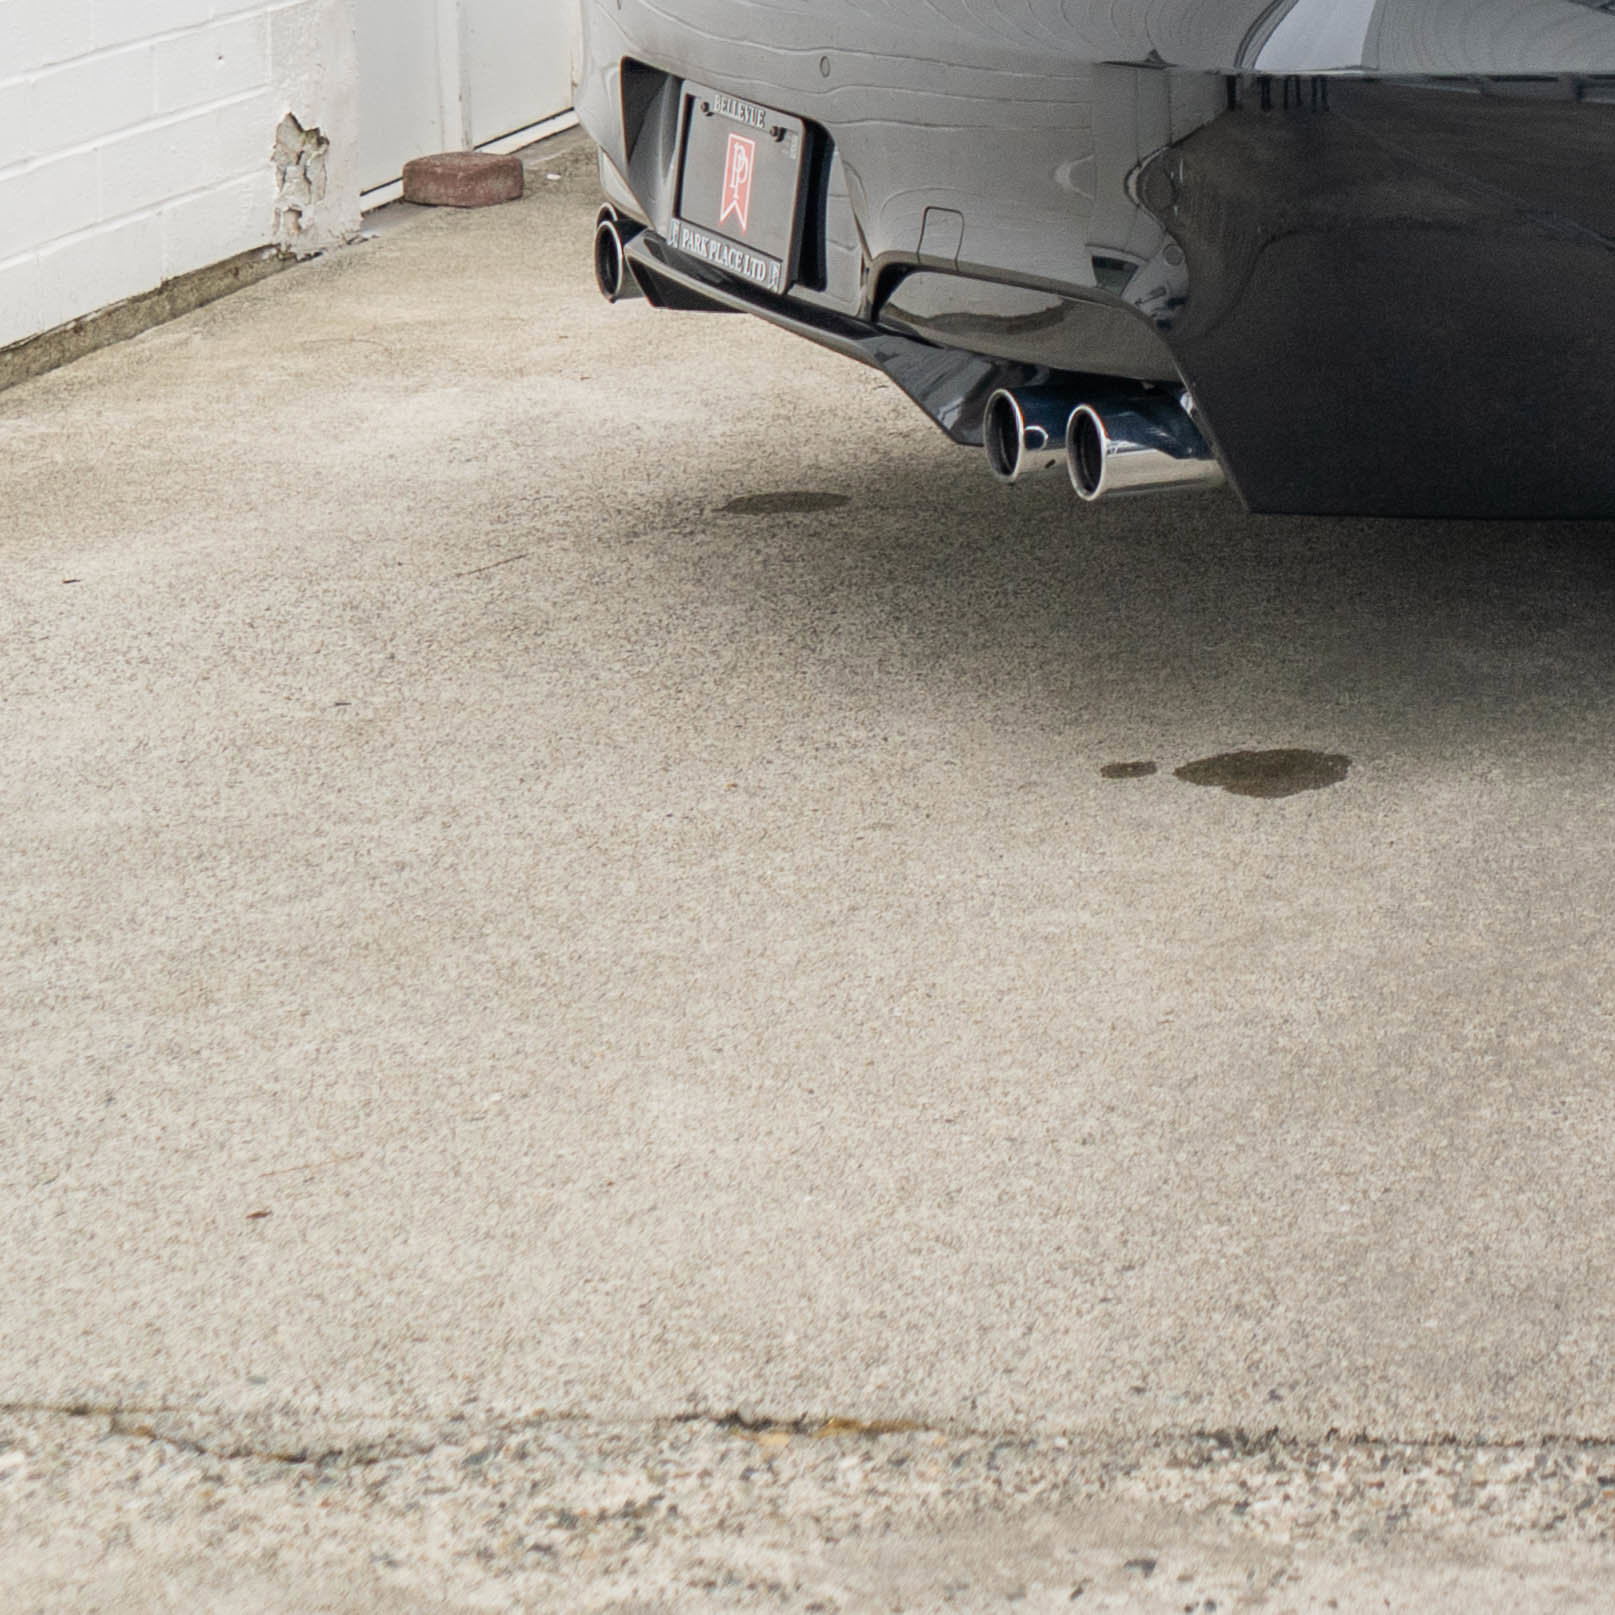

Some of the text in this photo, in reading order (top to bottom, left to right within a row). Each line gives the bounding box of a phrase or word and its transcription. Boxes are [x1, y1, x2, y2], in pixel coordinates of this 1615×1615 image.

[713, 94, 766, 129] BELLEVUE
[682, 228, 709, 257] PARK
[708, 239, 745, 272] PLACE
[744, 254, 767, 282] LTD
